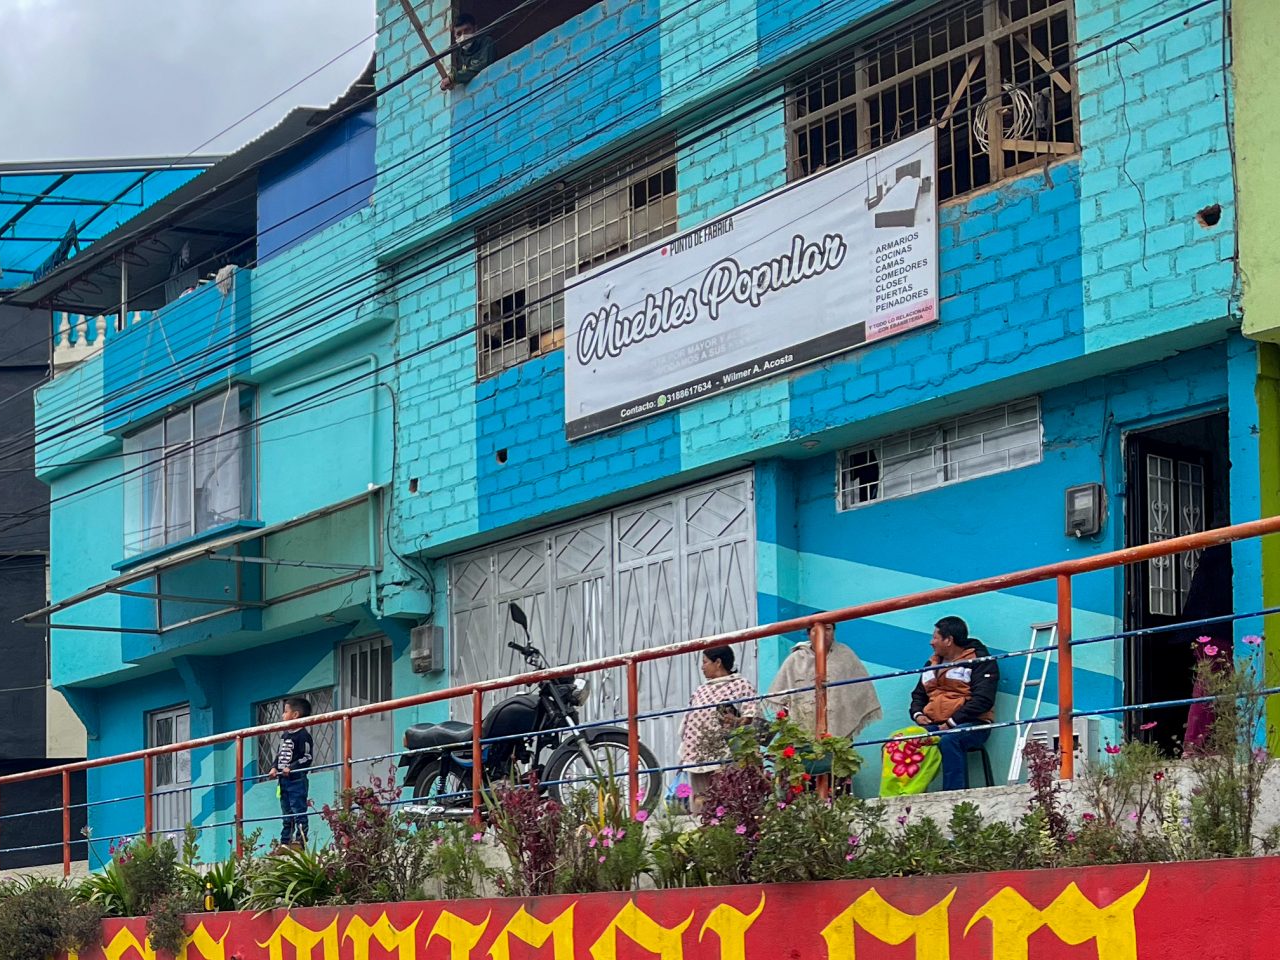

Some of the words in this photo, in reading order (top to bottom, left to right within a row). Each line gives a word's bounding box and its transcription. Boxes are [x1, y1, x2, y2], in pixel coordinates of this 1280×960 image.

[669, 235, 693, 256] PUNTO
[694, 232, 703, 246] DE
[875, 232, 919, 254] ARMARIOS
[875, 244, 913, 264] COCINAS
[875, 256, 905, 274] CAMAS
[875, 258, 928, 283] COMEDORES
[875, 275, 909, 293] CLOSET
[875, 283, 913, 303] PUERTAS
[576, 286, 698, 366] Muebles
[700, 234, 848, 320] Popular
[875, 288, 929, 313] PEINADORES
[873, 320, 888, 328] TODO
[687, 338, 717, 354] MAYOR
[620, 401, 656, 418] Contacto:
[722, 367, 751, 384] Wilmer
[753, 363, 762, 374] A.
[763, 353, 794, 370] Acosta
